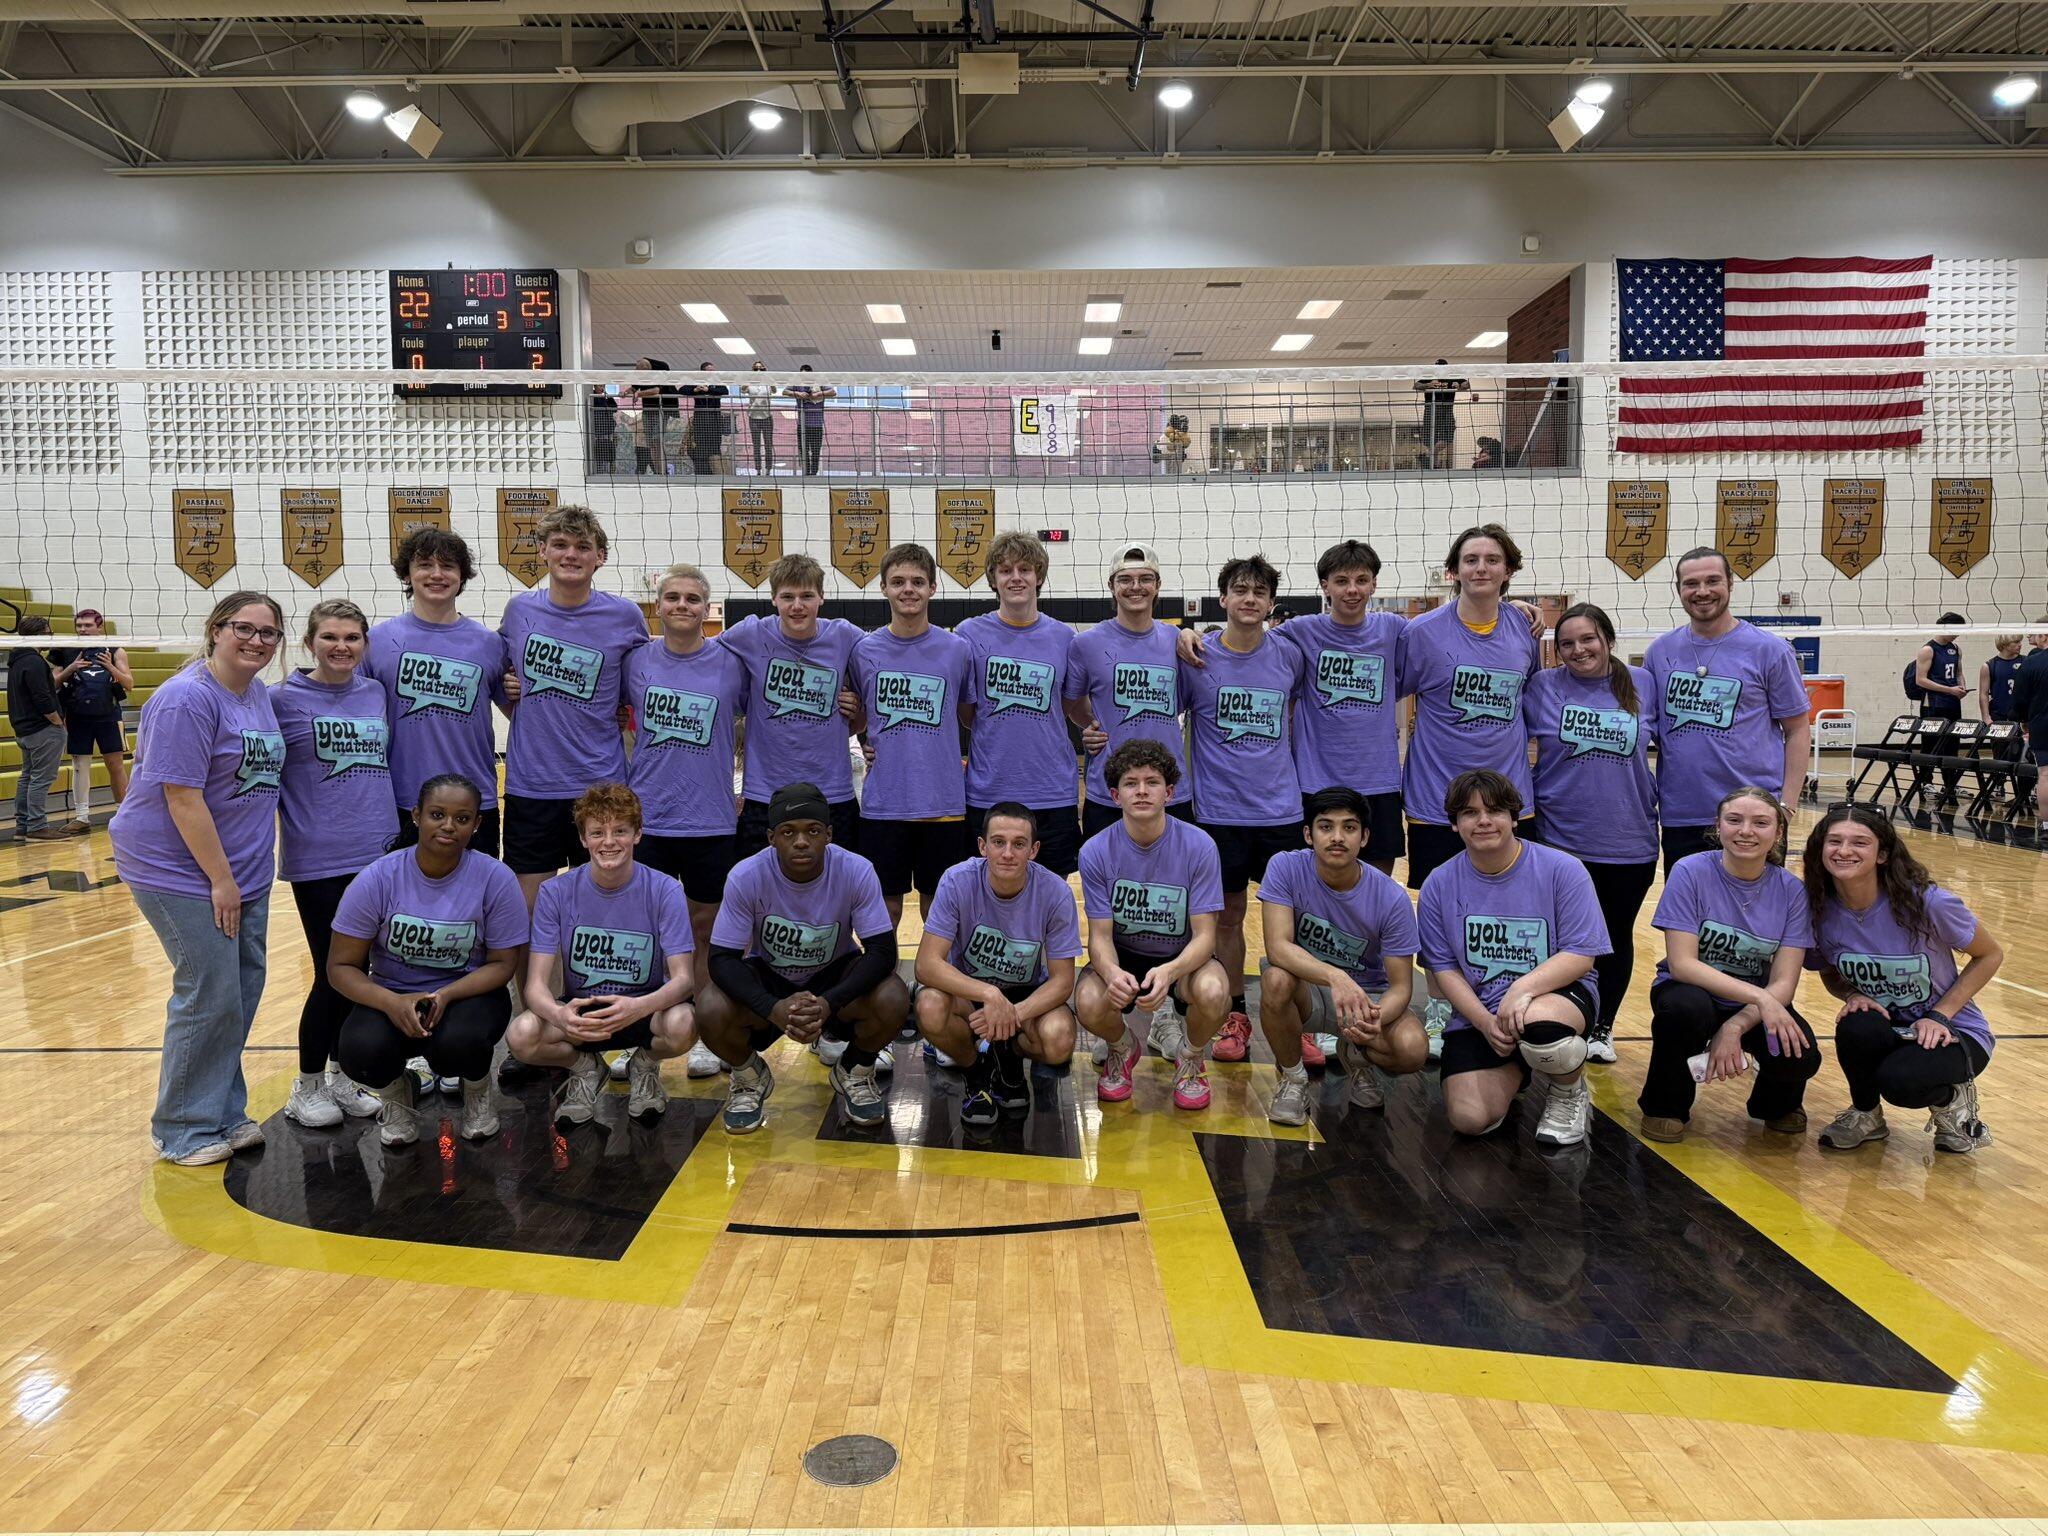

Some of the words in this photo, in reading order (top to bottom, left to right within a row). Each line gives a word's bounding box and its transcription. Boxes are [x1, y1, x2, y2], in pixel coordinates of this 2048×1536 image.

[398, 276, 424, 287] Home
[515, 274, 548, 286] Guests
[400, 292, 430, 318] 22
[521, 291, 552, 317] 25
[457, 314, 488, 326] period
[497, 310, 508, 330] 3
[402, 337, 424, 348] fouls
[458, 336, 488, 348] player
[523, 336, 545, 348] fouls
[1020, 398, 1040, 434] E
[526, 639, 564, 666] you
[400, 657, 442, 684] you
[768, 664, 805, 690] you
[988, 662, 1021, 688] you
[1320, 656, 1354, 680] you
[878, 678, 911, 702] you
[1116, 669, 1150, 694] you
[1455, 671, 1492, 698] you
[1668, 676, 1703, 703] you
[646, 692, 680, 718] you
[1220, 692, 1254, 718] you
[1563, 709, 1601, 731] you
[316, 721, 358, 748] you
[1113, 885, 1150, 914] you
[390, 921, 434, 946] you
[764, 921, 805, 946] you
[968, 930, 1006, 957] you
[1300, 918, 1335, 946] you
[1468, 922, 1508, 952] you
[1699, 928, 1740, 954] you
[573, 932, 615, 962] you
[1841, 960, 1887, 986] you
